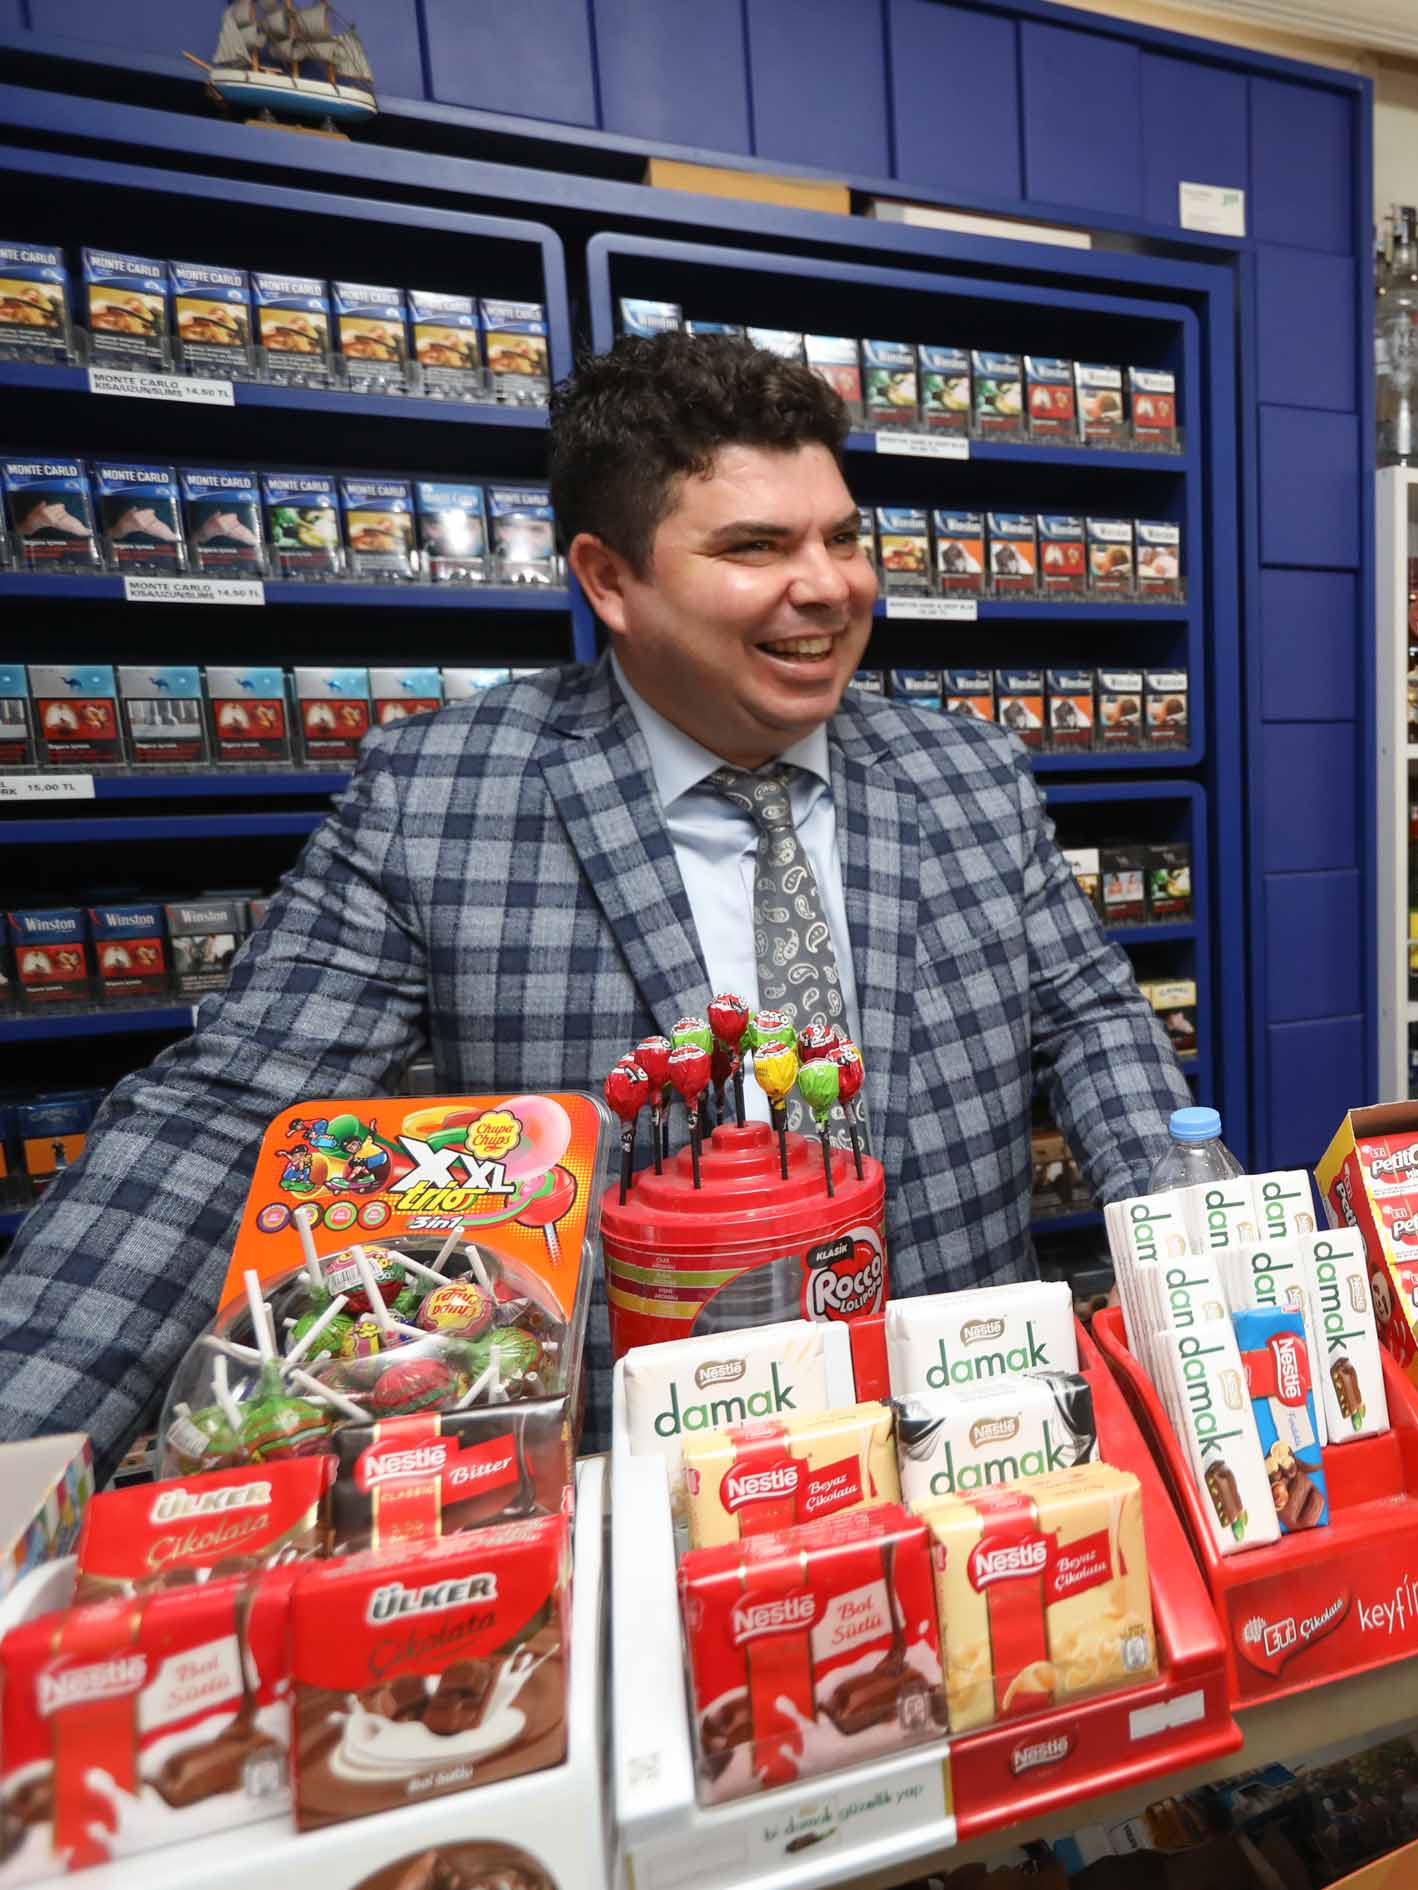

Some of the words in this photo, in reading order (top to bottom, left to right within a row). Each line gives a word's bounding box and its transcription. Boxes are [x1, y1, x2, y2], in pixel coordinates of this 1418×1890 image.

[91, 255, 124, 272] MONTE
[127, 262, 160, 277] CARLO
[177, 268, 208, 282] MONTE
[210, 272, 242, 287] CARLO
[94, 373, 136, 386] MONTE
[140, 377, 179, 389] CARLO
[8, 463, 43, 476] MONTE
[44, 464, 77, 477] CARLO
[103, 469, 136, 482] MONTE
[137, 471, 169, 483] CARLO
[188, 474, 220, 487] MONTE
[221, 476, 251, 489] CARLO
[268, 480, 299, 491] MONTE
[300, 481, 329, 493] CARLO
[129, 581, 170, 591] MONTE
[63, 783, 76, 791] TL
[25, 916, 76, 932] Winston
[105, 912, 155, 926] Winston
[181, 909, 228, 923] Winston
[472, 1133, 511, 1148] Chups
[476, 1123, 514, 1136] Chupa
[388, 1135, 517, 1194] XXL
[396, 1180, 489, 1212] trio
[408, 1215, 464, 1230] 3in1
[1205, 1190, 1246, 1249] dam
[1262, 1182, 1301, 1238] dam
[1131, 1204, 1172, 1262] dam
[815, 1244, 850, 1263] KLASİK
[1314, 1241, 1366, 1355] damak
[926, 1321, 1051, 1390] damak
[654, 1361, 798, 1438] damak
[1178, 1336, 1243, 1456] damak
[450, 1455, 513, 1485] Bitter
[930, 1419, 1068, 1497] damak
[806, 1482, 858, 1514] Çikolata
[808, 1472, 848, 1497] Beyaz
[151, 1481, 272, 1524] ÜLKER
[147, 1511, 271, 1570] Çikolata
[1057, 1550, 1097, 1573] Beyaz
[1055, 1560, 1108, 1592] Çikolata
[366, 1573, 498, 1624] ÜLKER
[838, 1594, 874, 1619] Bol
[831, 1612, 884, 1646] Sütlü
[1300, 1596, 1344, 1639] Çikolata
[367, 1608, 498, 1681] Çikolata
